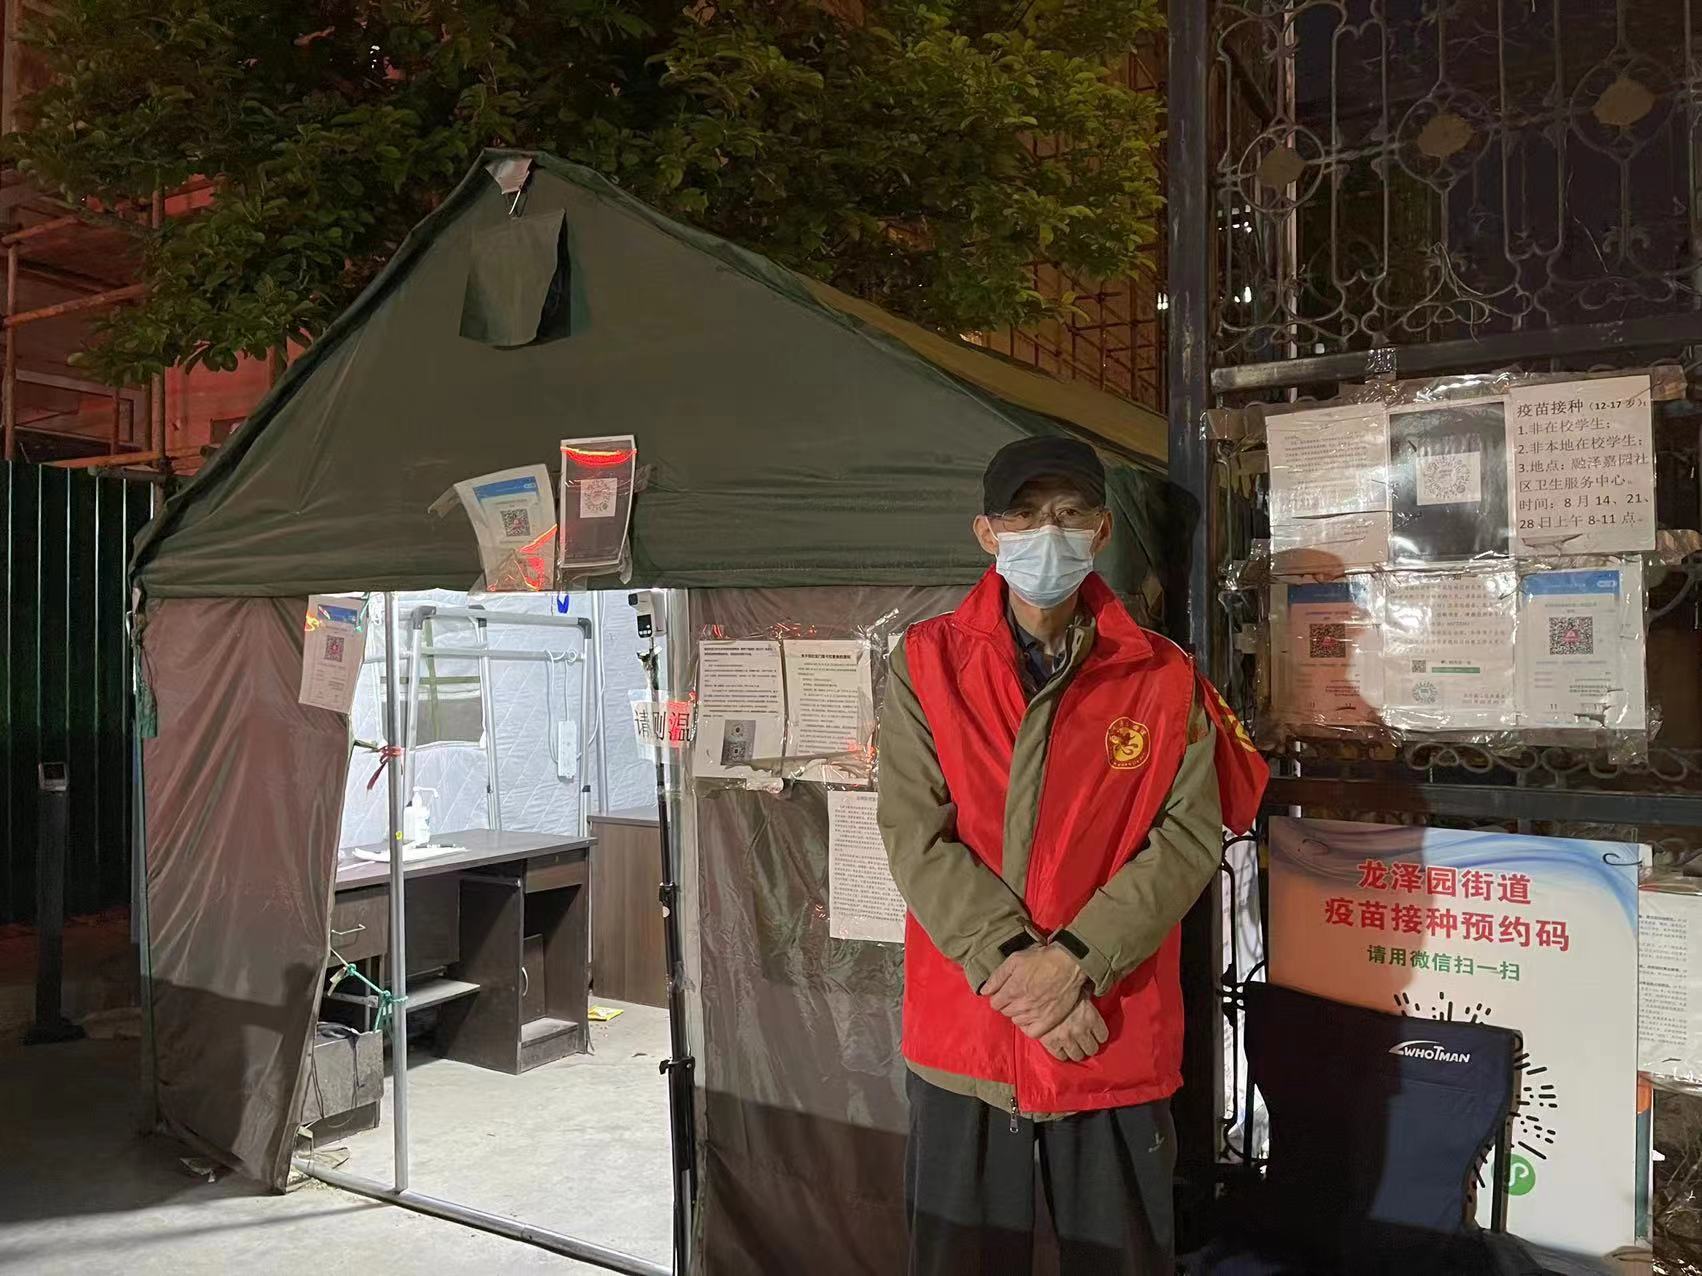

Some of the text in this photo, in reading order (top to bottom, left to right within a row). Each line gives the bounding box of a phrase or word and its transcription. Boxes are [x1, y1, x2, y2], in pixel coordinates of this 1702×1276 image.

[1357, 859, 1532, 905] 龙泽园街道
[1324, 897, 1570, 952] 疫苗接种预约码
[1367, 945, 1521, 982] 请用微信扫一扫
[1402, 1045, 1471, 1064] WHOTMAN
